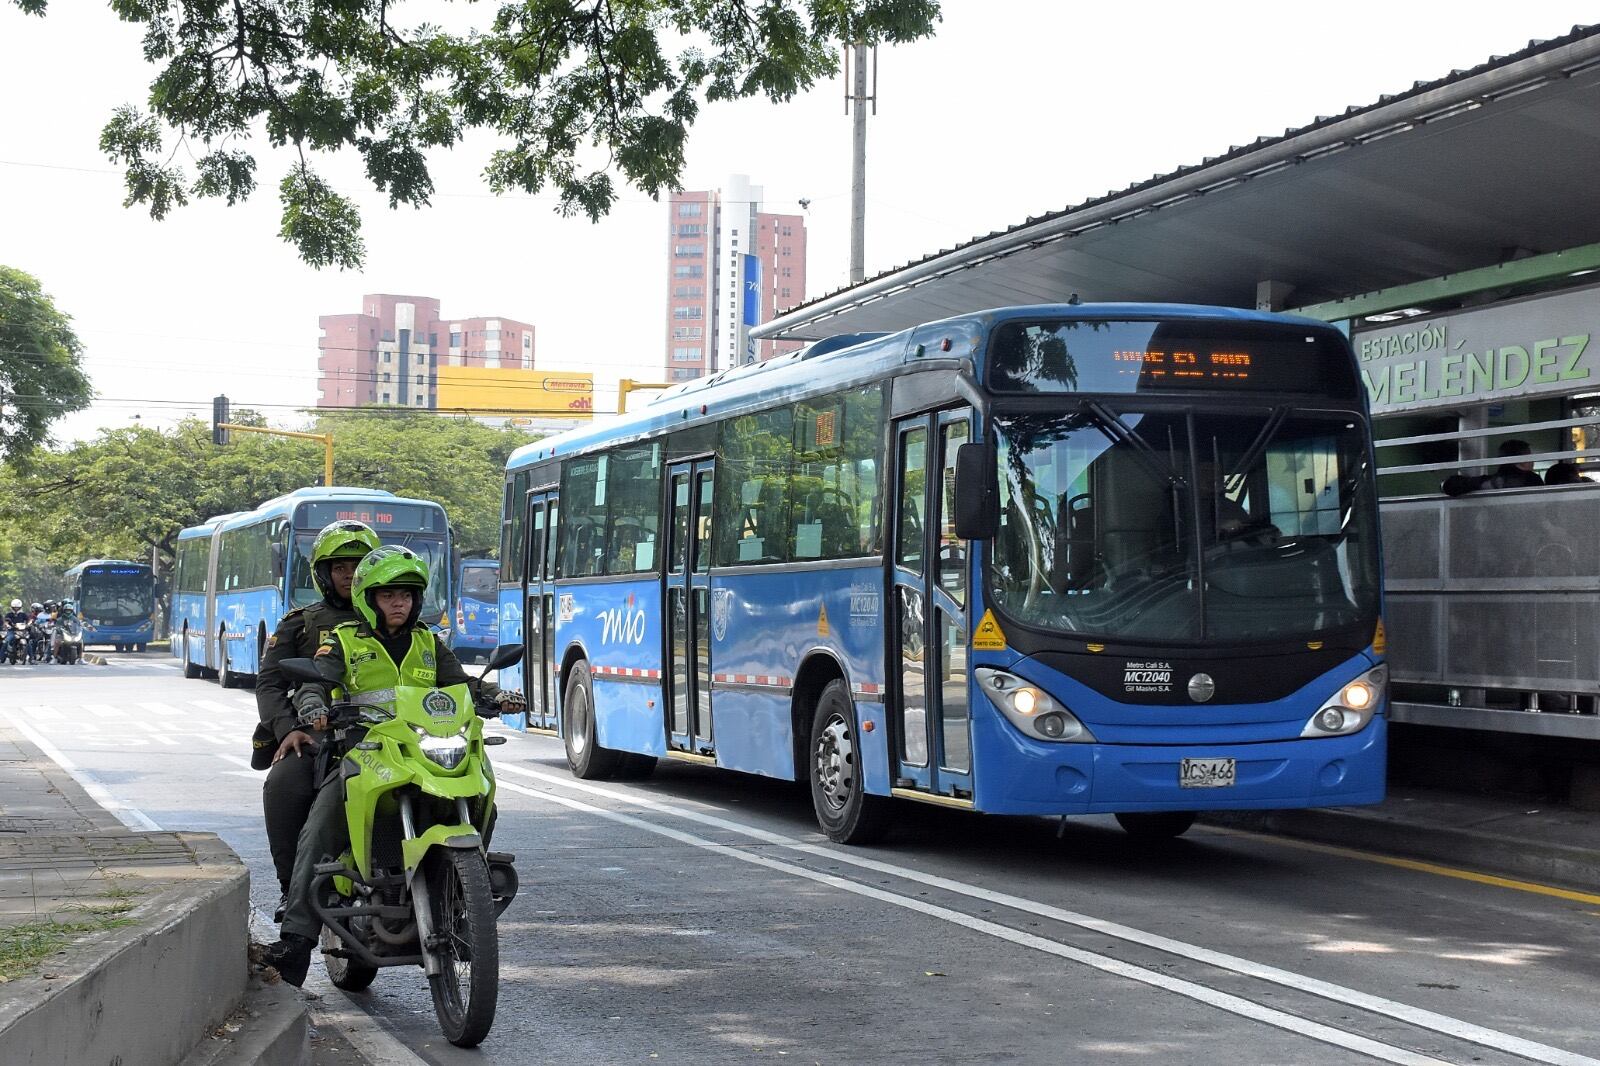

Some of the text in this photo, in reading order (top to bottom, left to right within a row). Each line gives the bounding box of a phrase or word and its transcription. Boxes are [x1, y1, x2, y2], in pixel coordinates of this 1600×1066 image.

[1361, 323, 1447, 362] ESTACIÓN
[1361, 333, 1591, 406] MELÉNDEZ
[361, 512, 373, 523] EL
[595, 605, 645, 645] mio
[1124, 671, 1171, 683] MC12040
[1127, 661, 1171, 669] Metro Cali S.A.
